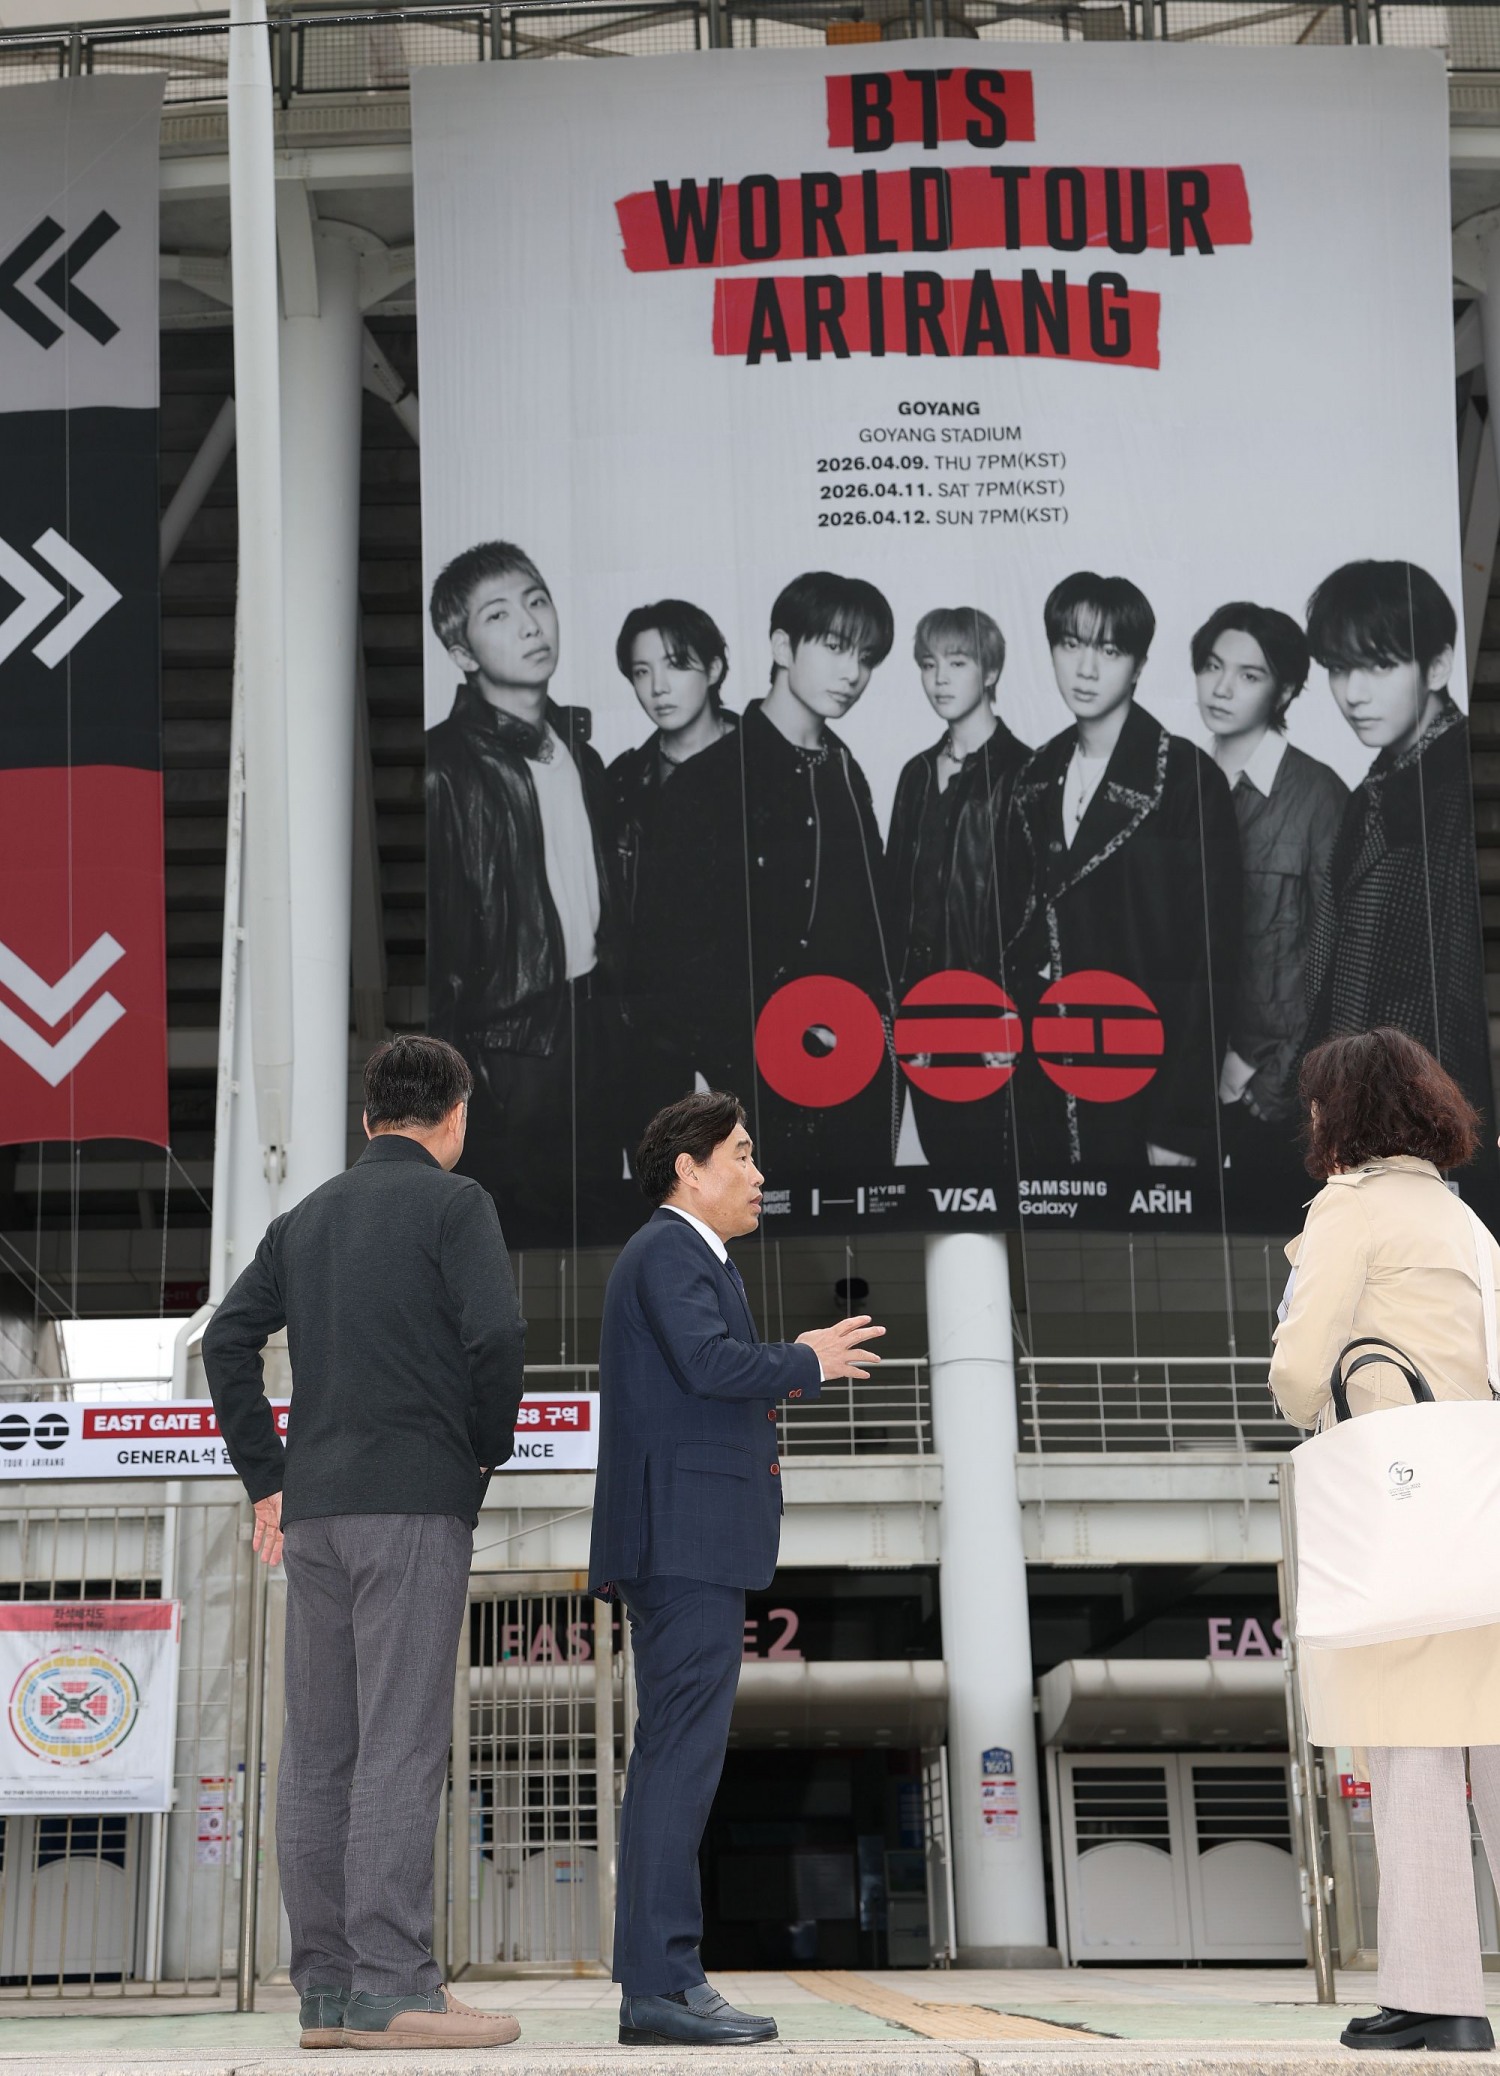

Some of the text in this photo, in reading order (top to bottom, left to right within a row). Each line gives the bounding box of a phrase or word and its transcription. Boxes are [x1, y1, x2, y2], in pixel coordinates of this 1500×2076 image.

[852, 68, 1006, 153] BTS
[653, 165, 1215, 265] WORLD TOUR
[746, 269, 1131, 365] ARIRANG
[898, 401, 980, 416] GOYANG
[859, 426, 1022, 443] GOYANG STADIUM
[817, 452, 1067, 473] 2026.04.09. THU 7PM(KST)
[820, 480, 1066, 500] 2026.04.11. SAT 7PM(KST)
[818, 507, 1069, 527] 2026.04.12. SUN 7PM(KST)
[868, 1184, 906, 1196] HYBE
[1018, 1180, 1108, 1197] SAMSUNG
[927, 1187, 997, 1213] VISA
[1018, 1200, 1079, 1218] Galaxy
[1129, 1189, 1193, 1214] ARIH
[93, 1414, 146, 1432] EAST
[149, 1413, 202, 1431] GATE
[544, 1405, 579, 1426] 구역
[117, 1447, 216, 1465] GENERAL석
